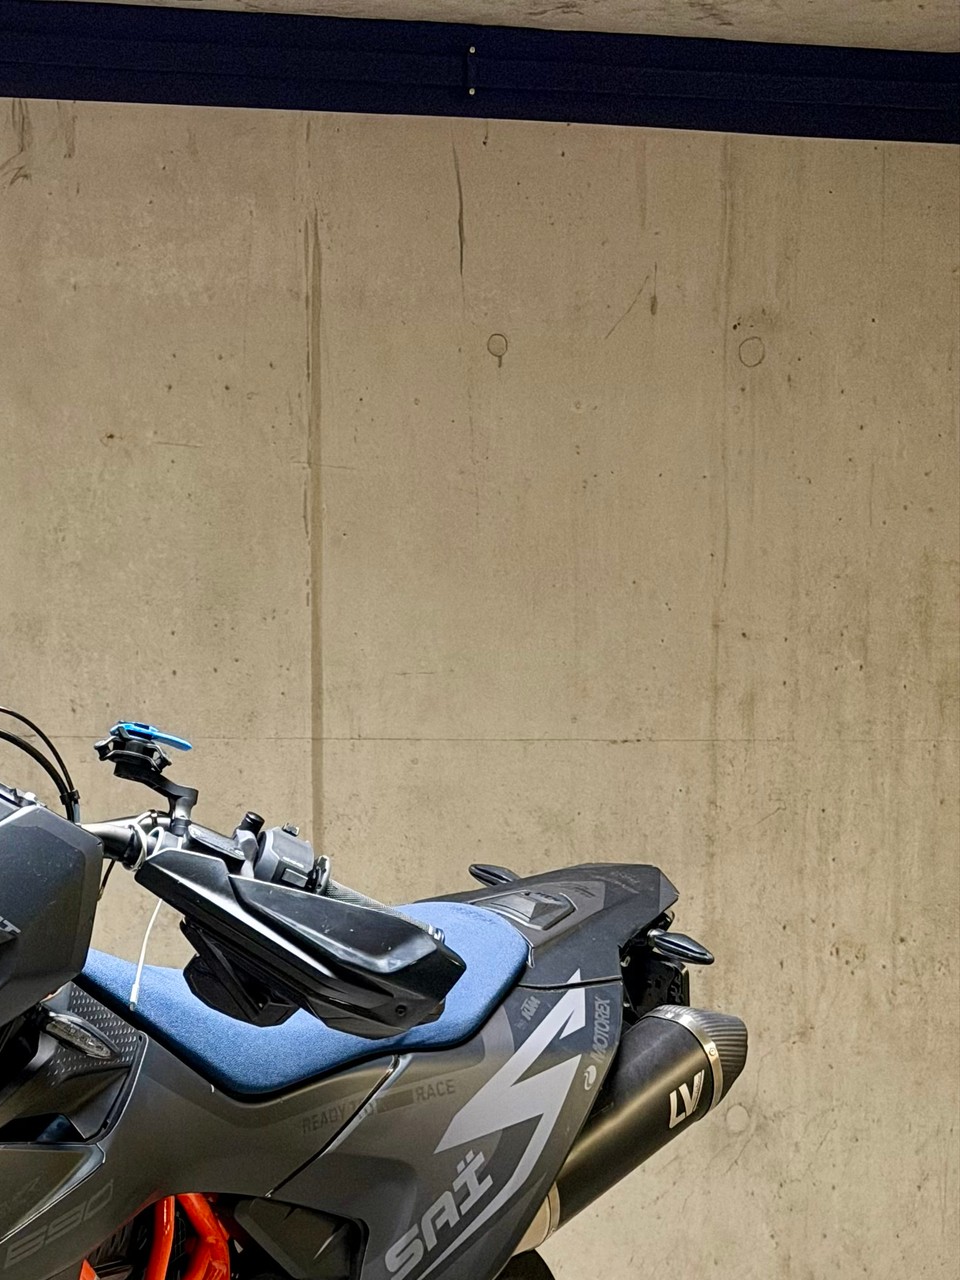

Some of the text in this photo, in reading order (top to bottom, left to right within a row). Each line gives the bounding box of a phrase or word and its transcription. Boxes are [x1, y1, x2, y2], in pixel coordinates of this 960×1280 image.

[520, 996, 540, 1021] KTM
[590, 996, 611, 1062] MOTOREX
[302, 1101, 348, 1134] READY
[415, 1079, 456, 1102] RACE
[669, 1069, 705, 1129] LV
